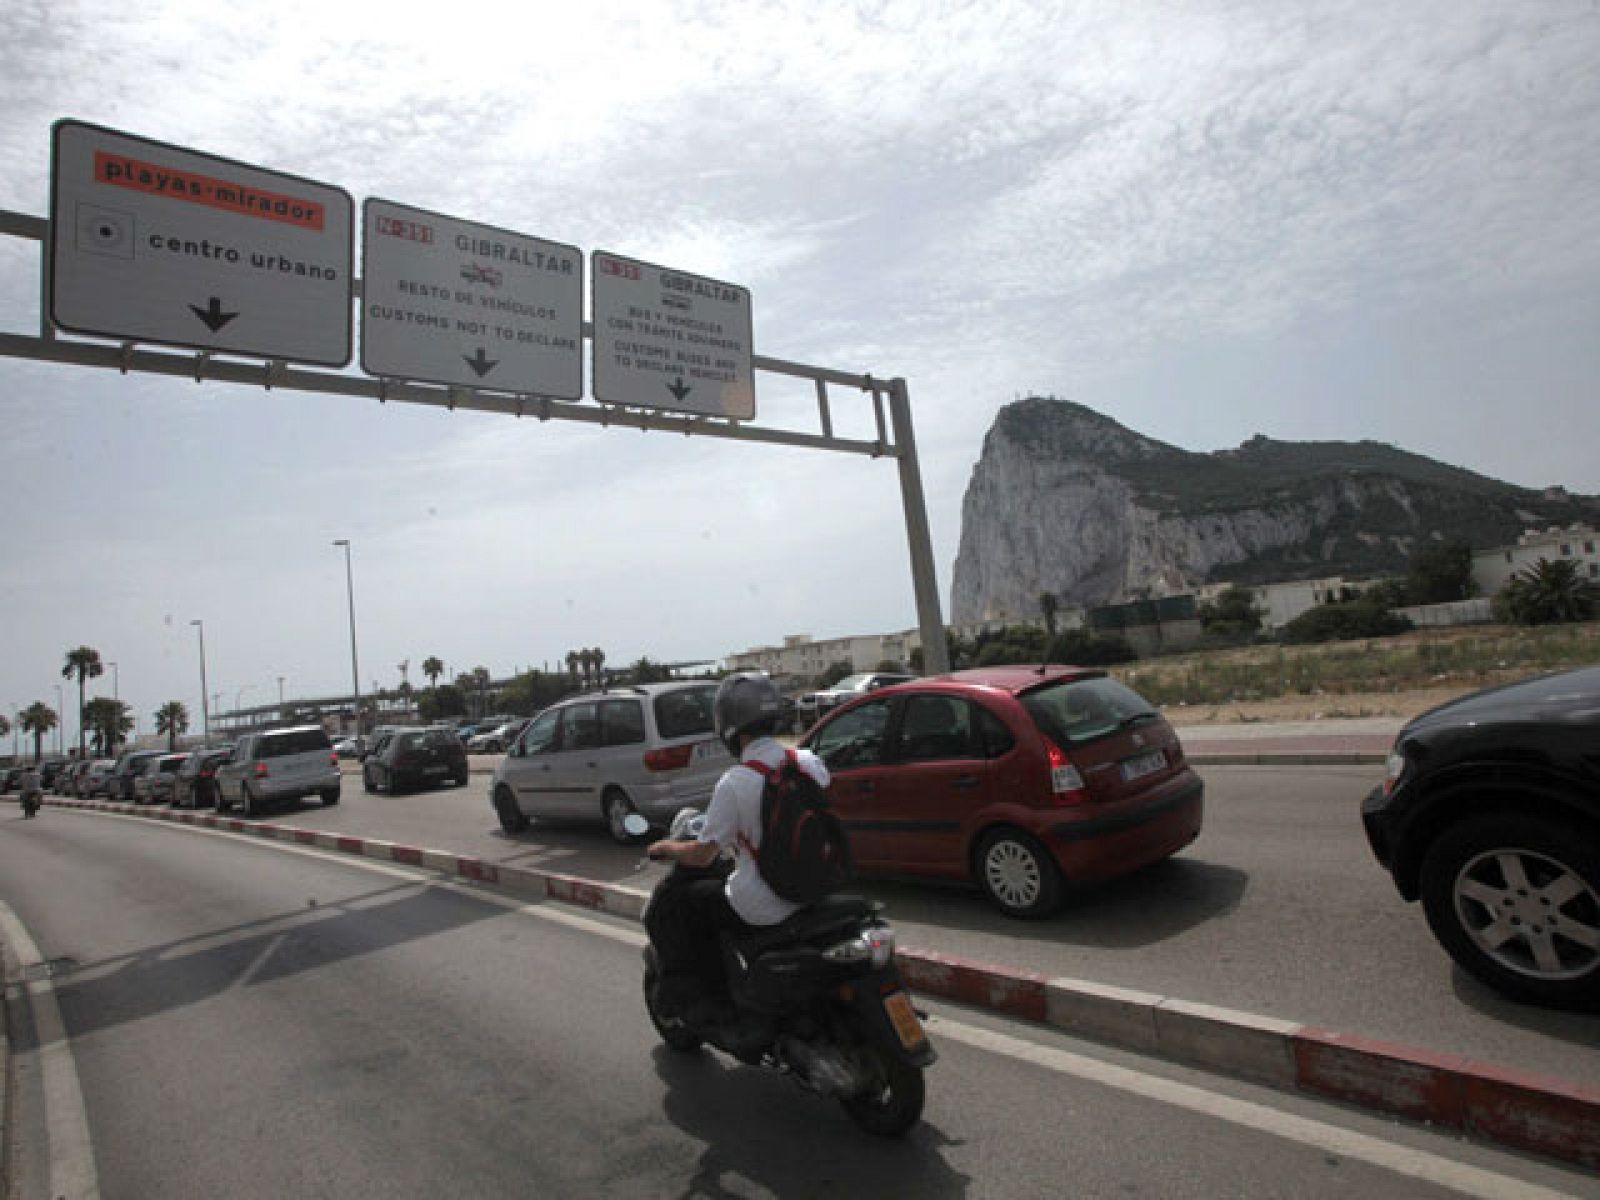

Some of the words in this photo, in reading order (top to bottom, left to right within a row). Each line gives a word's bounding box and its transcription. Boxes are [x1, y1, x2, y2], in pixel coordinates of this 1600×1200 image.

[150, 234, 240, 263] centro
[251, 252, 337, 281] urbano
[455, 234, 573, 274] GIBRALTAR
[398, 280, 450, 300] RESTO
[454, 291, 474, 305] DE
[659, 272, 740, 302] GIBRALTAR
[369, 304, 449, 329] CUSTOMS
[456, 319, 488, 336] NOT
[495, 327, 514, 341] TO
[516, 331, 576, 349] DECLARE
[614, 355, 631, 366] TO
